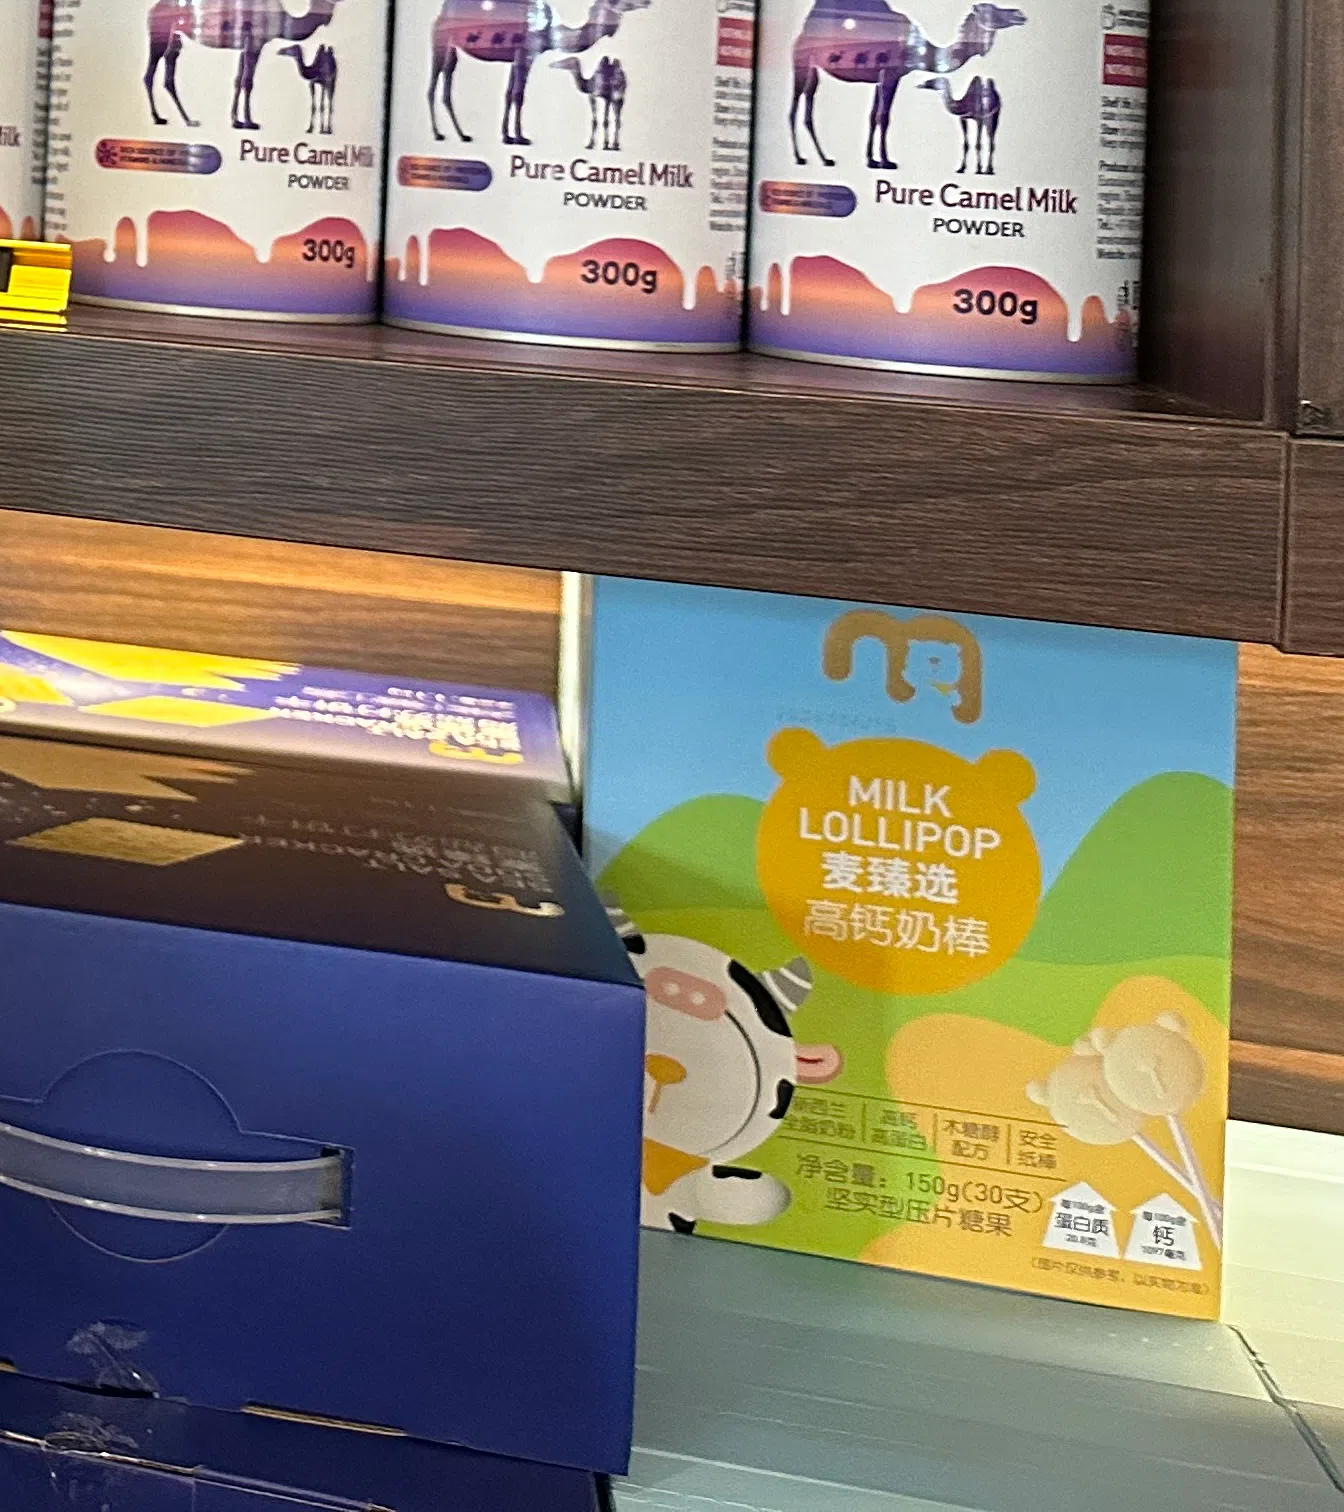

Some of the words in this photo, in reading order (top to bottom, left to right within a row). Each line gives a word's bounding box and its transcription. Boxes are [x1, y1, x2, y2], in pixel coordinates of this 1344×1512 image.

[240, 139, 290, 164] Pure
[294, 143, 347, 167] Camel
[288, 175, 349, 191] POWDER
[511, 156, 564, 182] Pure
[570, 159, 644, 186] Camel
[651, 163, 694, 189] Milk
[564, 192, 647, 210] POWDER
[876, 179, 932, 207] Pure
[940, 184, 1021, 211] Camel
[1028, 187, 1078, 214] Milk
[933, 218, 1025, 238] POWDER
[303, 239, 355, 268] 300g
[581, 260, 657, 294] 300g
[953, 289, 1038, 325] 300g
[848, 776, 952, 818] MILK
[799, 809, 1001, 860] LOLLIPOP
[822, 852, 959, 904] 麦臻选
[804, 899, 991, 956] 高钙奶棒
[951, 1140, 989, 1161] 配方
[1019, 1130, 1057, 1150] 安全
[826, 1189, 1013, 1238] 坚实型压片糖果
[1054, 1212, 1109, 1236] 蛋白质
[1153, 1226, 1175, 1246] 钙
